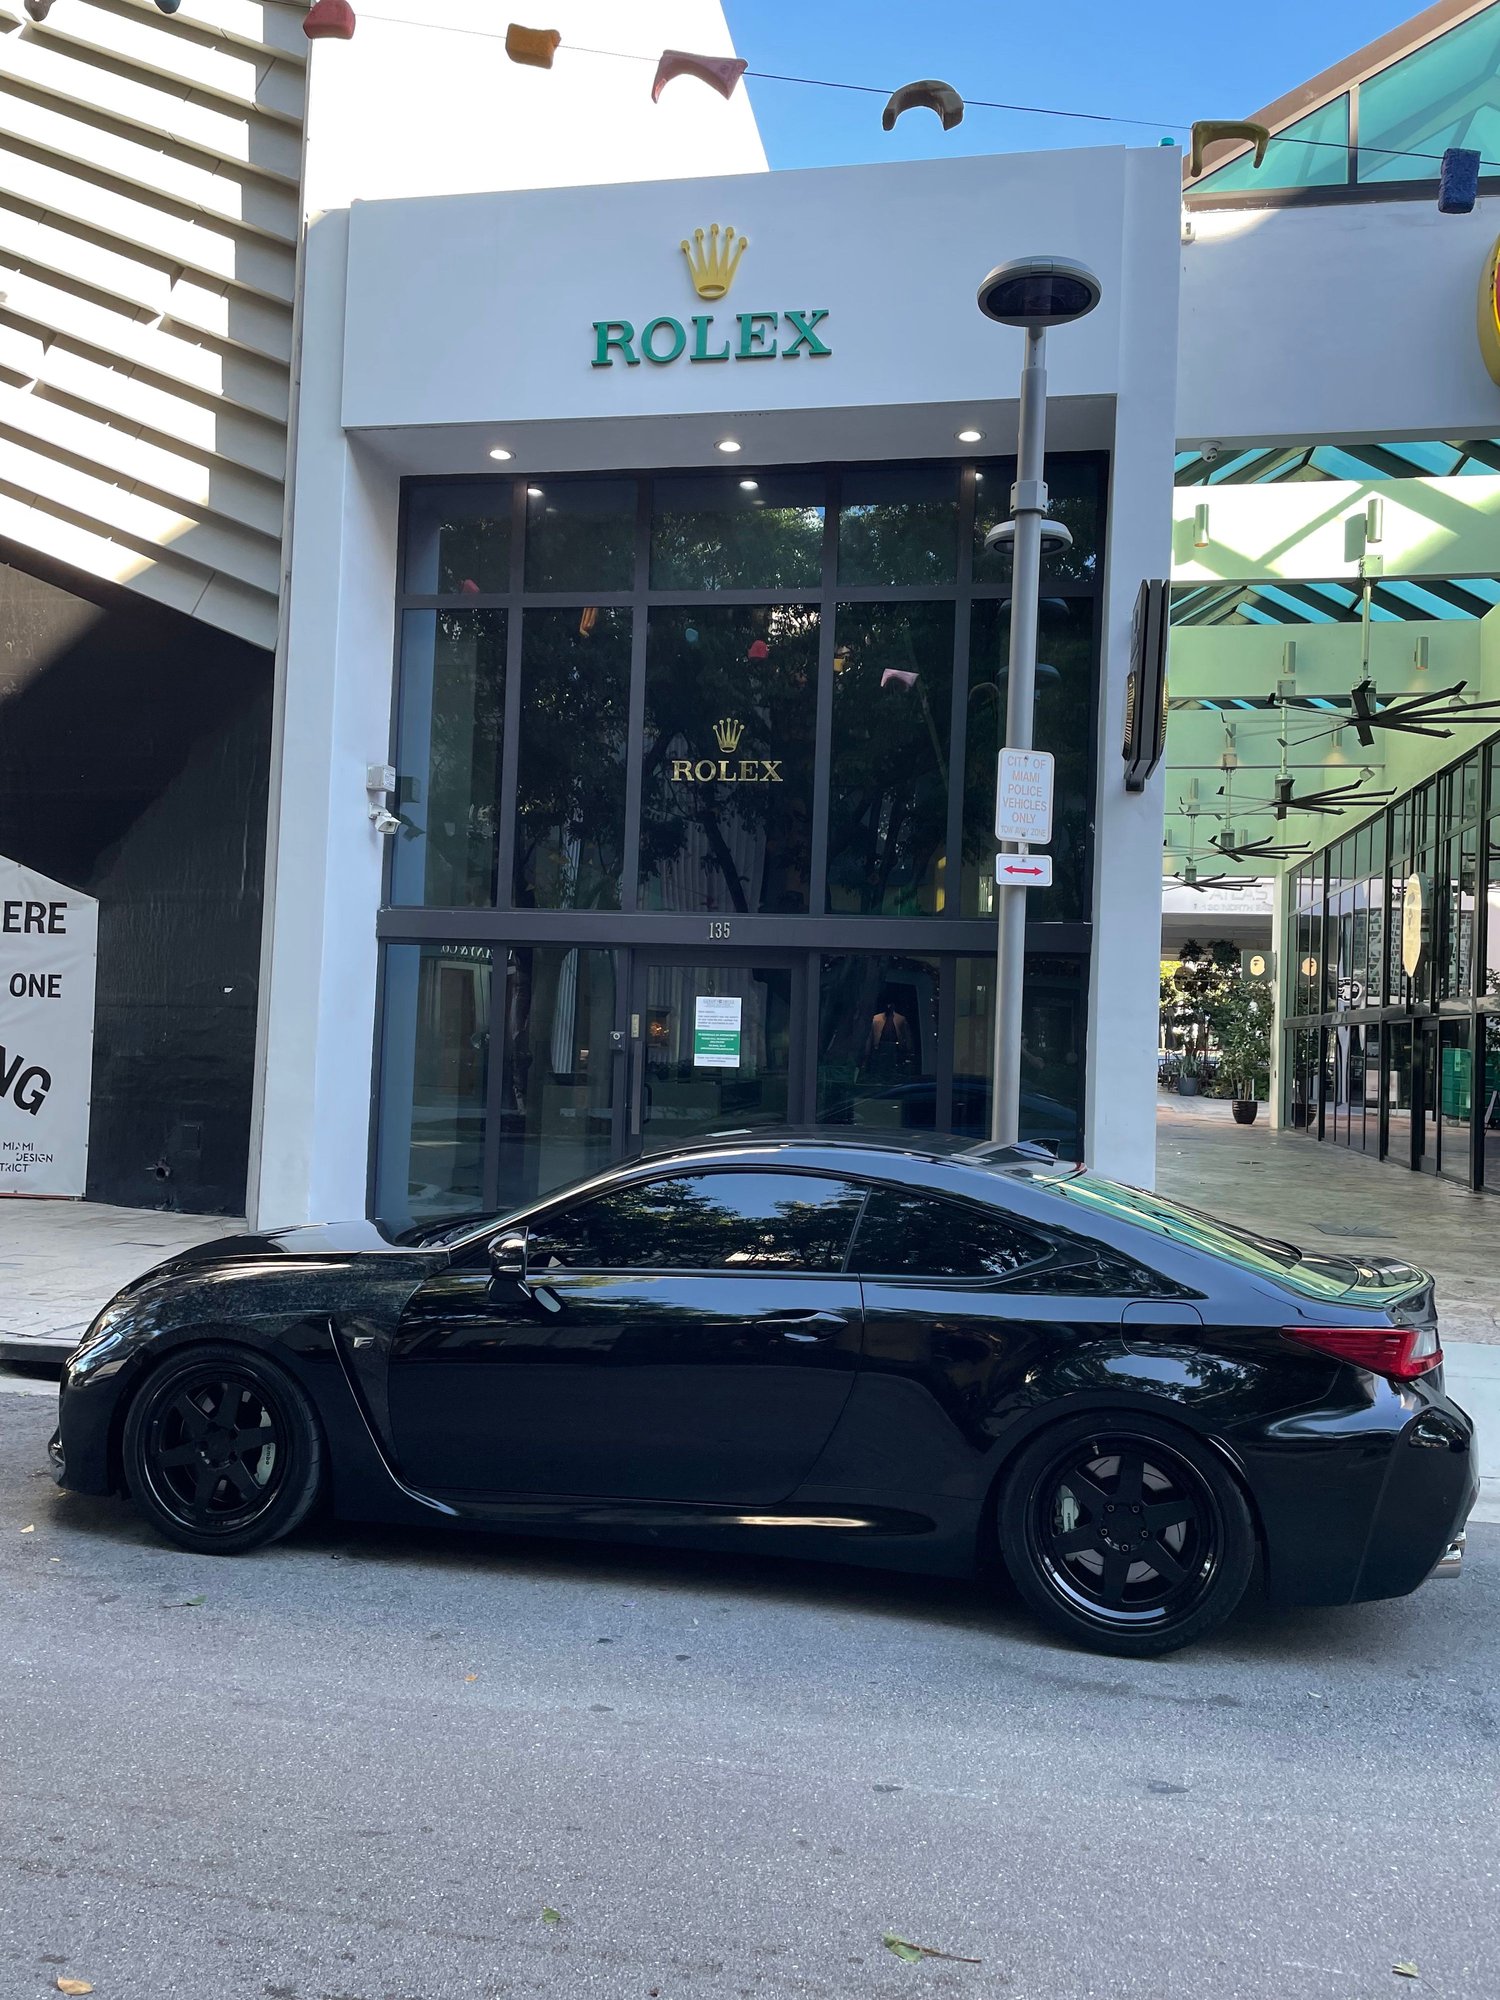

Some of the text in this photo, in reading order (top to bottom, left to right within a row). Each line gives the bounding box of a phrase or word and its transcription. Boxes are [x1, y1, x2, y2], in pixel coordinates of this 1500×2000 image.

[591, 309, 832, 367] ROLEX
[1007, 755, 1046, 769] CITY OF
[671, 760, 784, 782] ROLEX
[1012, 770, 1040, 783] MIAMI
[1008, 784, 1042, 797] POLICE
[1003, 797, 1046, 811] VEHICLES
[1012, 812, 1036, 823] ONLY
[1031, 828, 1046, 837] ZONE
[2, 901, 68, 934] ERE
[709, 922, 731, 939] 135
[9, 973, 62, 998] ONE
[3, 1141, 34, 1151] MIAMI
[16, 1152, 53, 1163] DESIGN
